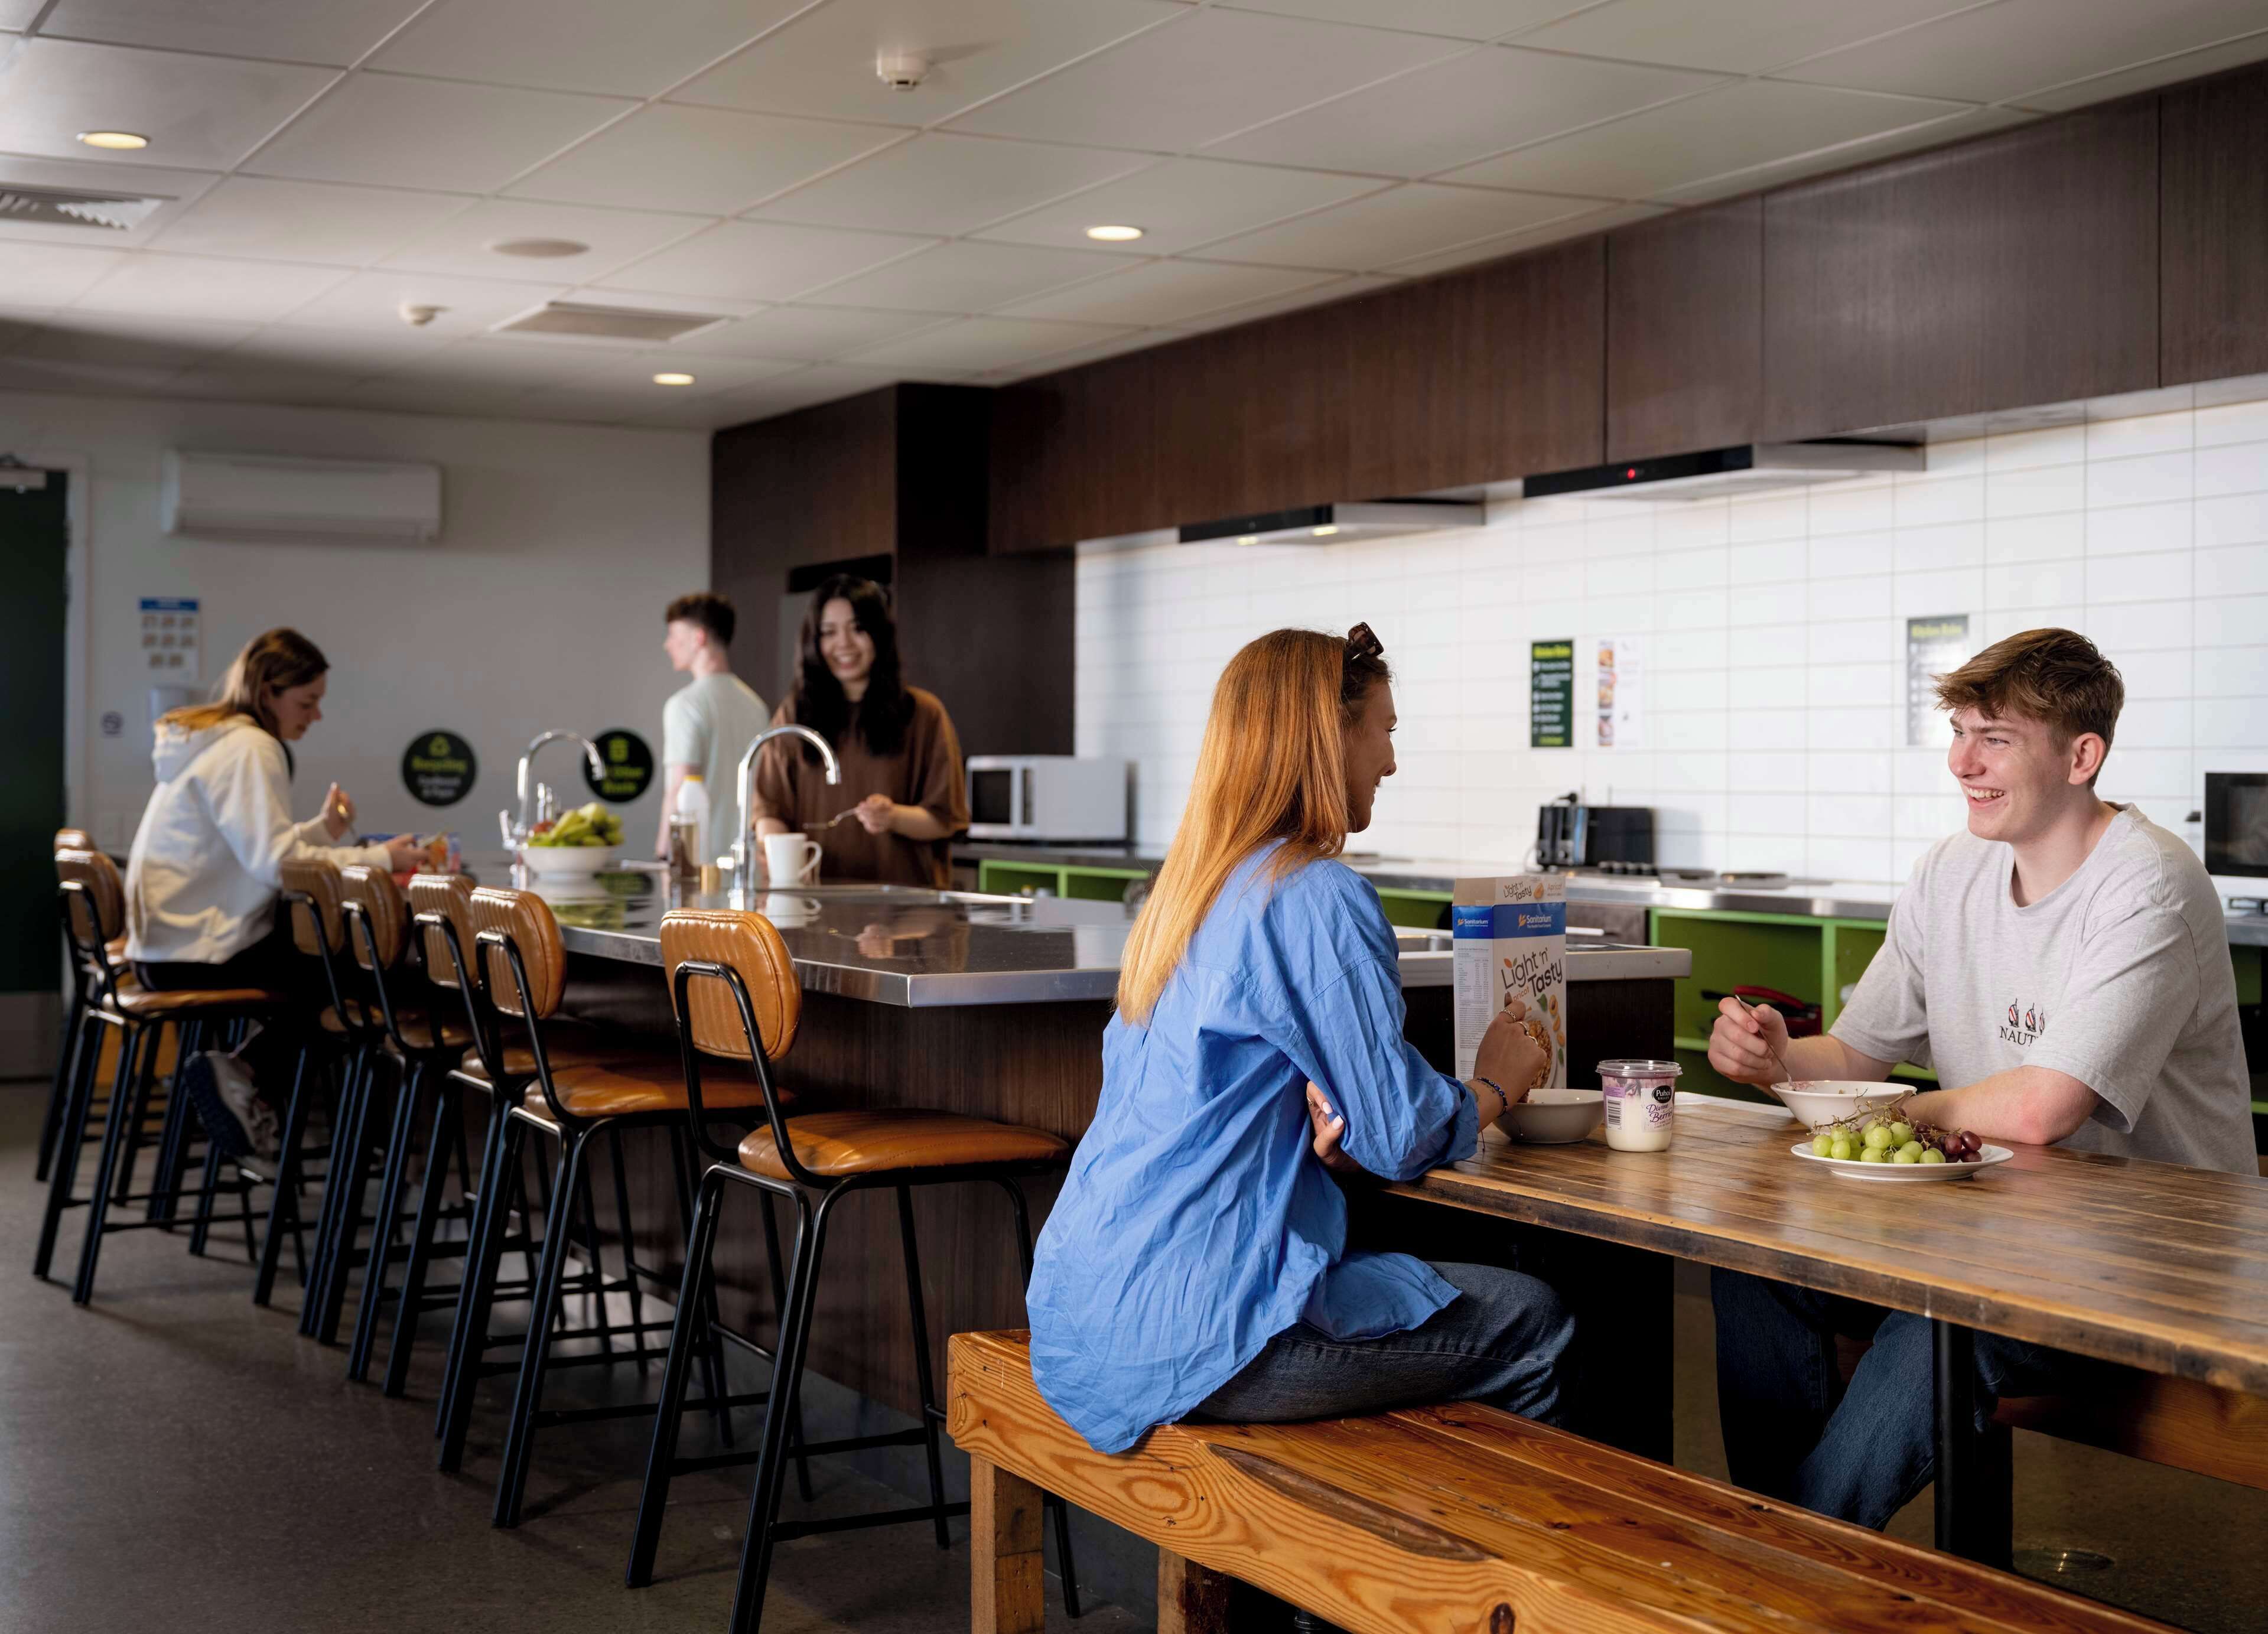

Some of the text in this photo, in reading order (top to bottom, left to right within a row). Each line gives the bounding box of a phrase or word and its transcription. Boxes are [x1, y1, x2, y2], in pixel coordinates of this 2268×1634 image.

[1504, 883, 1518, 898] Light
[1514, 886, 1531, 901] Tasty
[1527, 915, 1551, 923] Sanitarium
[1501, 952, 1538, 989] Light
[1527, 959, 1563, 997] Tasty
[1513, 985, 1530, 1001] pricot
[1999, 1026, 2038, 1047] NAUT
[1646, 1104, 1669, 1113] Divine
